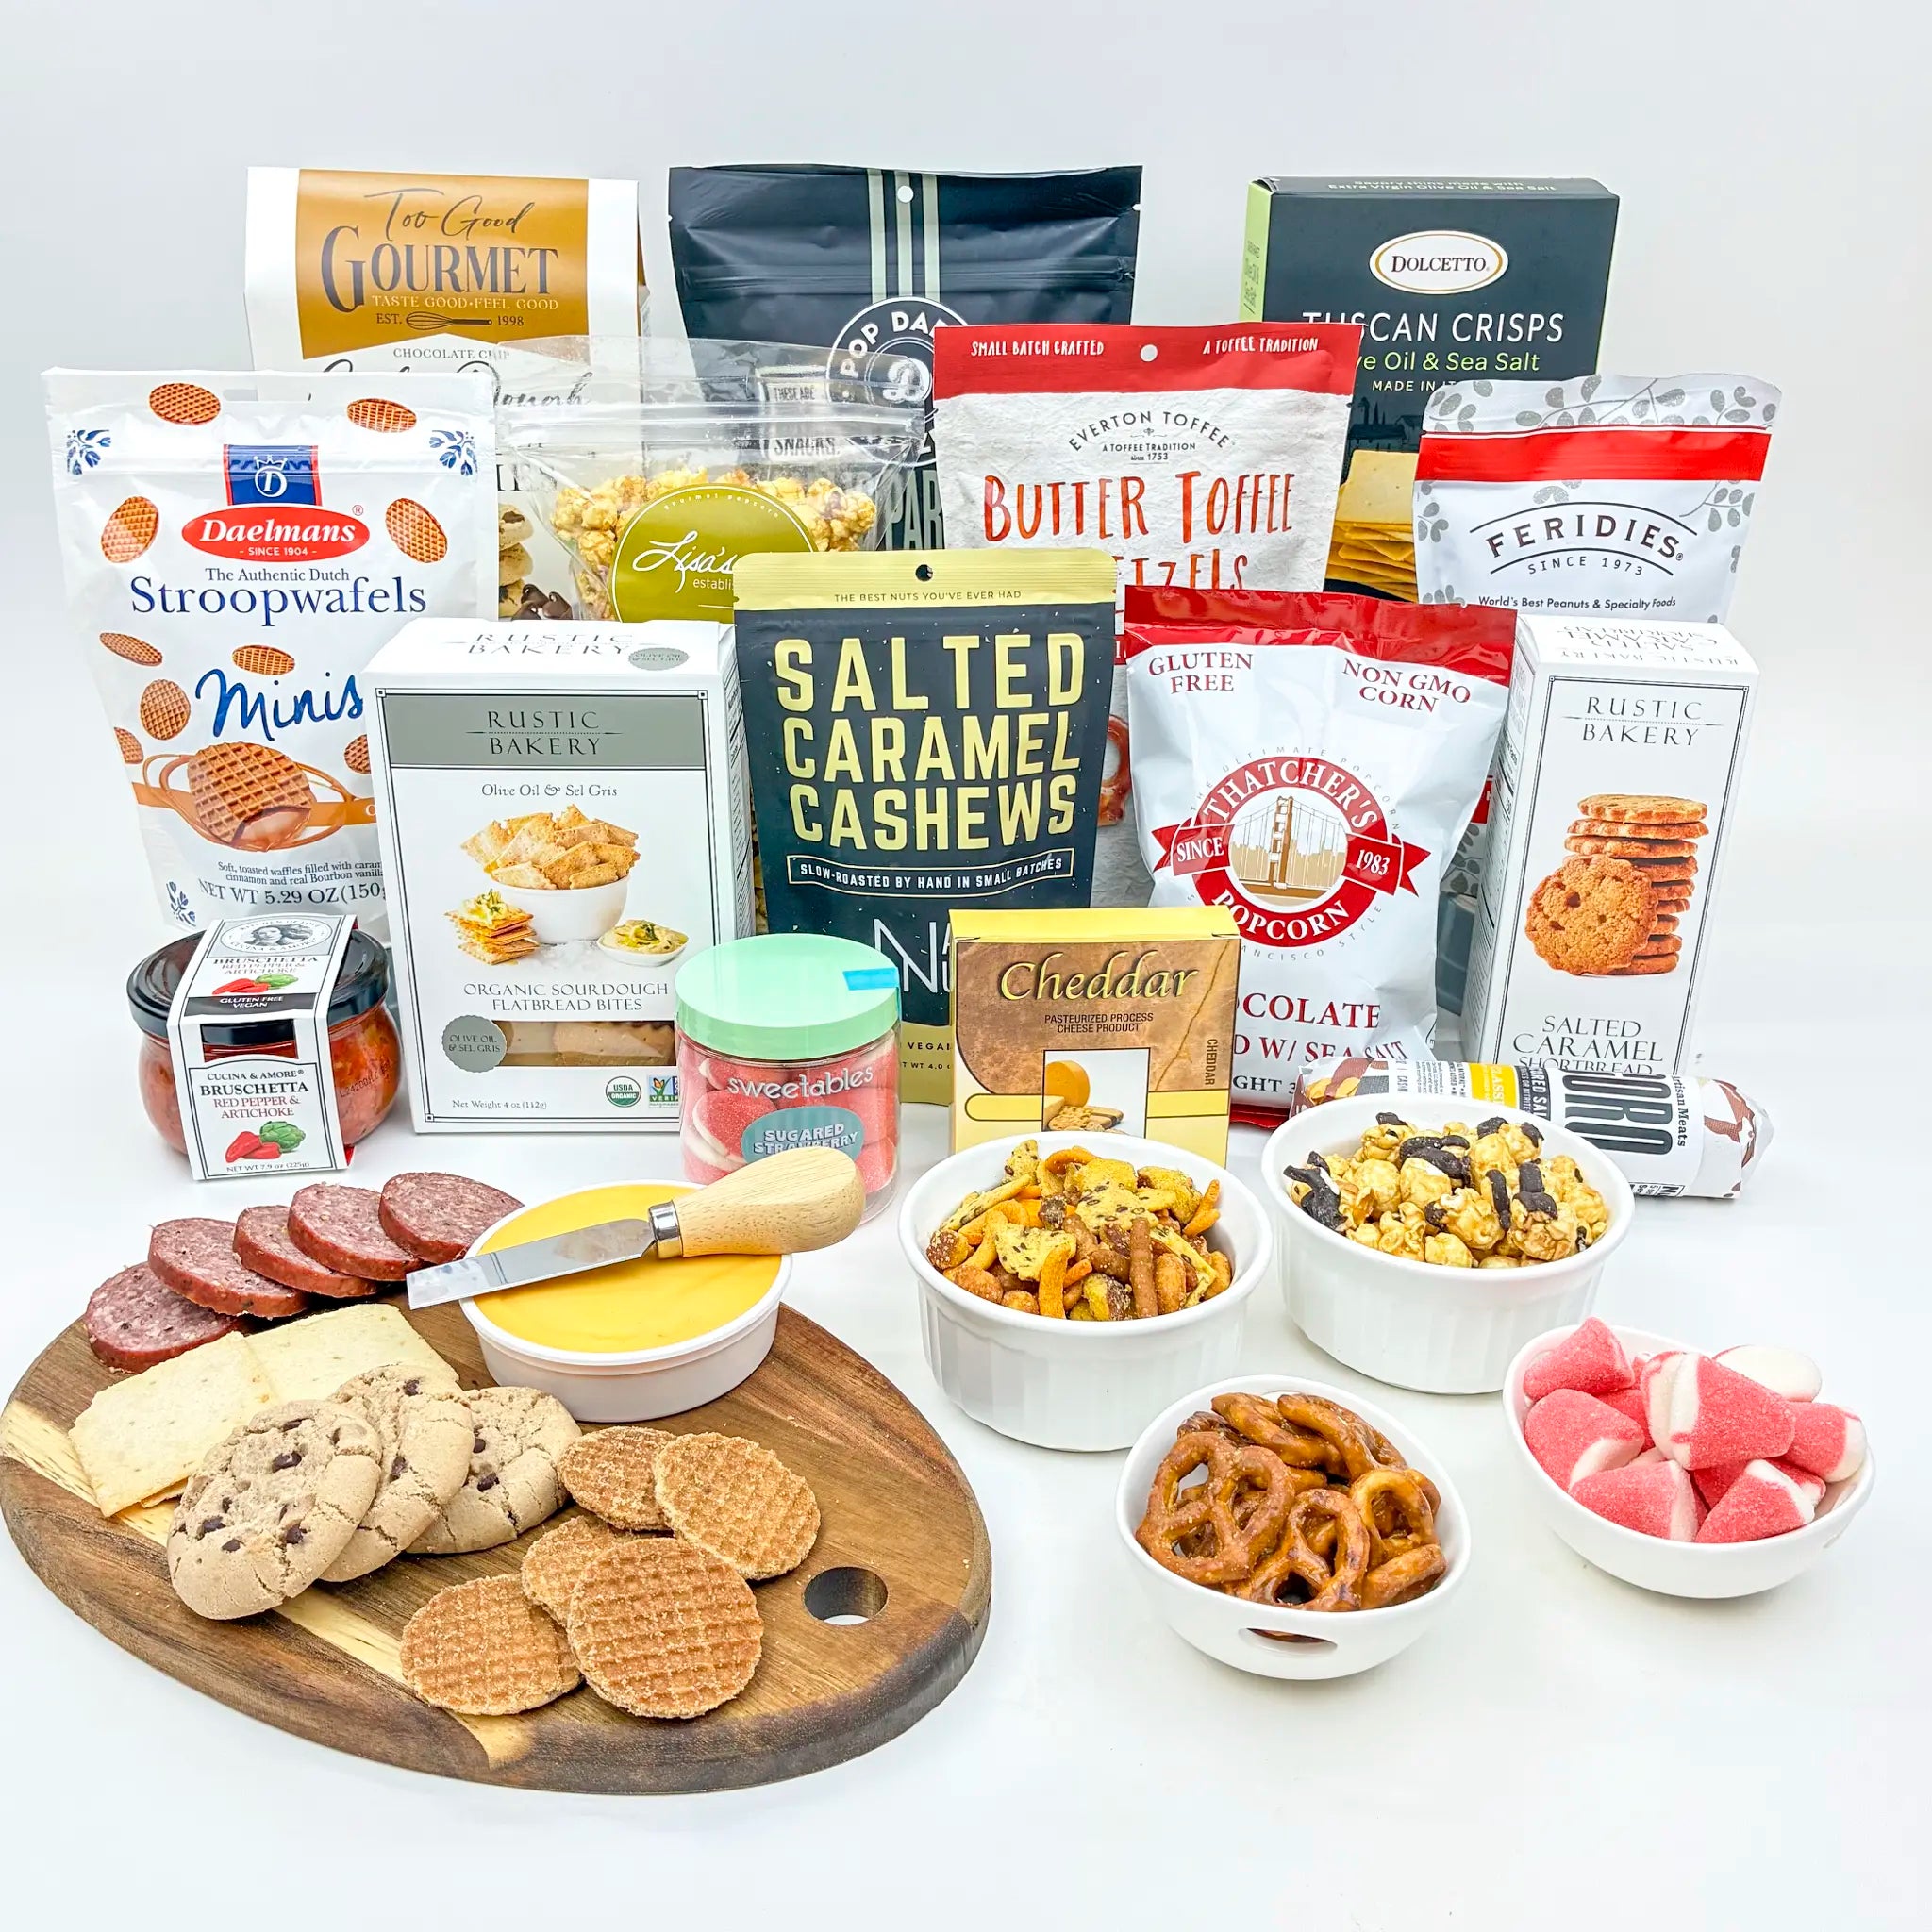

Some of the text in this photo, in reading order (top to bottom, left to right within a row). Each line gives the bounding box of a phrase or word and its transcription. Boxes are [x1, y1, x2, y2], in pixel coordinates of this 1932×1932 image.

[364, 188, 535, 241] Too Good
[321, 226, 558, 313] GOURMET
[1391, 255, 1486, 273] DOLCETTO
[372, 295, 420, 308] TASTE
[516, 297, 558, 310] GOOD
[376, 312, 525, 326] EST. 1998
[1451, 312, 1564, 342] CRISPS
[393, 348, 475, 358] CHOCOLATE
[971, 340, 1105, 357] SMALL BATCH CRAFTED
[1203, 337, 1319, 355] A TOFFEE TRADITION
[1385, 352, 1415, 372] Oil
[1423, 352, 1440, 371] &
[1446, 353, 1488, 372] Sea
[1494, 351, 1540, 372] Salt
[1373, 380, 1414, 391] MADE
[1421, 380, 1436, 391] IN
[1069, 411, 1230, 452] EVERTON TOFFEE
[1102, 442, 1196, 452] A TOFFEE TRADITION
[1147, 453, 1169, 461] 1753
[984, 475, 1150, 541] BUTTER
[1176, 471, 1295, 544] TOFFEE
[199, 519, 356, 542] Daelmans
[248, 546, 308, 557] SINCE 1904
[632, 530, 738, 593] Lisa's
[1527, 556, 1644, 576] SINCE 1973
[205, 568, 350, 581] The Authentic Dutch
[130, 576, 427, 626] Stroopwafels
[835, 594, 855, 603] THE
[859, 593, 887, 602] BEST
[923, 592, 962, 601] YOU'VE
[967, 591, 995, 600] EVER
[999, 591, 1022, 599] HAD
[1478, 595, 1676, 611] World's Best Peanuts & Specialty Foods
[476, 633, 634, 642] RUSTIC
[468, 644, 632, 655] BAKERY
[774, 632, 1085, 712] SALTED
[1149, 651, 1253, 676] GLUTEN
[1171, 675, 1235, 693] FREE
[1342, 658, 1471, 705] NON GMO
[195, 669, 363, 741] Minis
[1358, 686, 1439, 712] CORN
[1587, 696, 1702, 720] RUSTIC
[487, 711, 599, 730] RUSTIC
[1582, 724, 1700, 746] BAKERY
[491, 737, 601, 756] BAKERY
[783, 710, 1080, 783] CARAMEL
[481, 783, 617, 797] Olive Oil & Sel Gris
[1203, 760, 1378, 828] THATCHER'S
[789, 774, 1076, 851] CASHEWS
[1176, 837, 1391, 876] SINCE 1983
[218, 861, 352, 876] Soft, toasted waffles filled with
[800, 858, 1062, 889] SLOW-ROASTED BY HAND IN SMALL BATCHES
[226, 874, 267, 885] cinnamon
[290, 875, 308, 885] real
[310, 873, 353, 883] Bourbon
[198, 878, 226, 900] NET
[229, 887, 259, 905] WT
[265, 890, 302, 904] 5.29
[1211, 891, 1349, 940] POPCORN
[1000, 950, 1199, 1001] Cheddar
[463, 983, 668, 997] ORGANIC SOURDOUGH
[492, 998, 643, 1011] FLATBREAD BITES
[1236, 993, 1380, 1028] COLATE
[1044, 1012, 1154, 1024] PASTEURIZED PROCESS
[1542, 1015, 1641, 1038] SALTED
[1058, 1023, 1140, 1033] CHEESE PRODUCT
[450, 1034, 497, 1043] OLIVE OIL
[458, 1043, 475, 1052] SEL
[476, 1043, 500, 1052] GRIS
[1513, 1033, 1663, 1061] CARAMEL
[1259, 1037, 1297, 1061] W/
[1205, 1039, 1218, 1086] CHEDDAR
[207, 1072, 249, 1081] CUCINA
[727, 1066, 874, 1099] sweetables
[200, 1082, 309, 1096] BRUSCHETTA
[214, 1097, 240, 1108] RED
[242, 1096, 288, 1107] PEPPER
[452, 1100, 469, 1108] Net
[470, 1100, 502, 1109] Weight
[221, 1108, 294, 1119] ARTICHOKE
[764, 1123, 844, 1142] SUGARED
[1678, 1108, 1690, 1147] Meats
